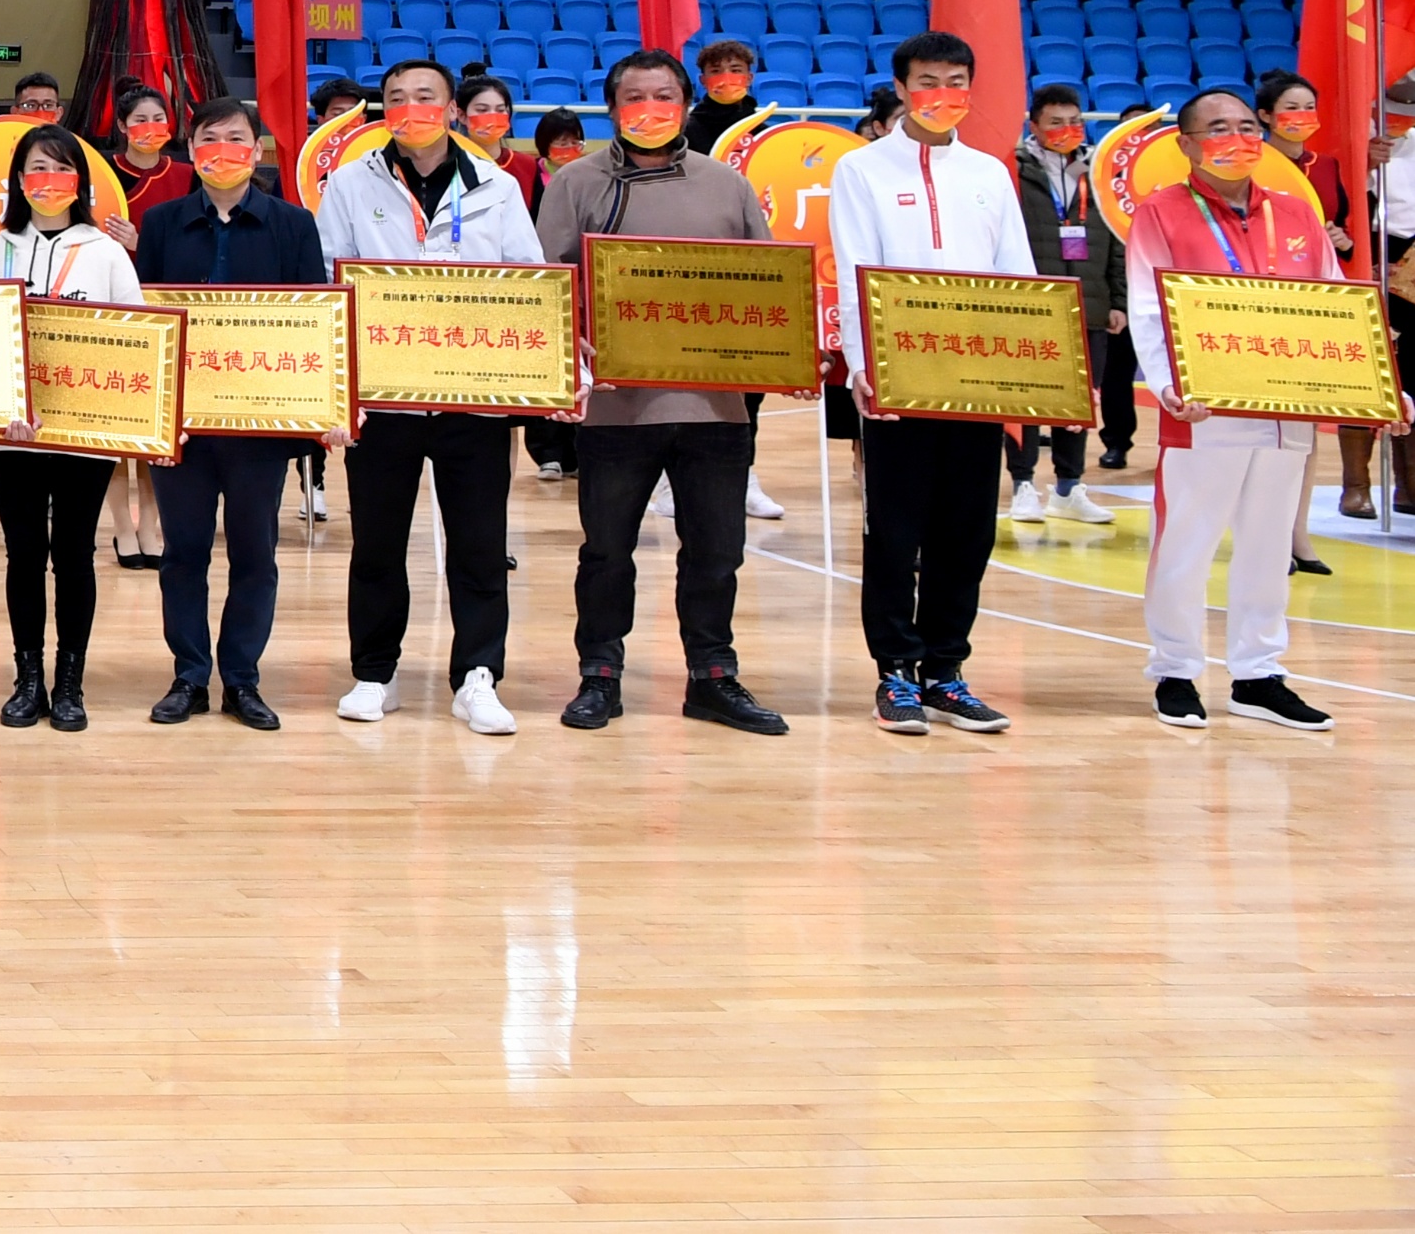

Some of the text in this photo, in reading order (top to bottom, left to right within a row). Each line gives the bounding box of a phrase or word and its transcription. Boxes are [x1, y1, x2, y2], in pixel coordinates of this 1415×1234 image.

[308, 3, 356, 31] 坝州
[187, 317, 319, 329] 第十六届少数民族传统体育运动会
[615, 300, 790, 328] 体育道德风尚奖
[28, 330, 150, 350] 十六届少数民族传统体育运动会
[366, 324, 548, 351] 体育道德风尚奖
[893, 331, 1061, 362] 体育道德风尚奖
[1196, 332, 1367, 363] 体育道德风尚奖
